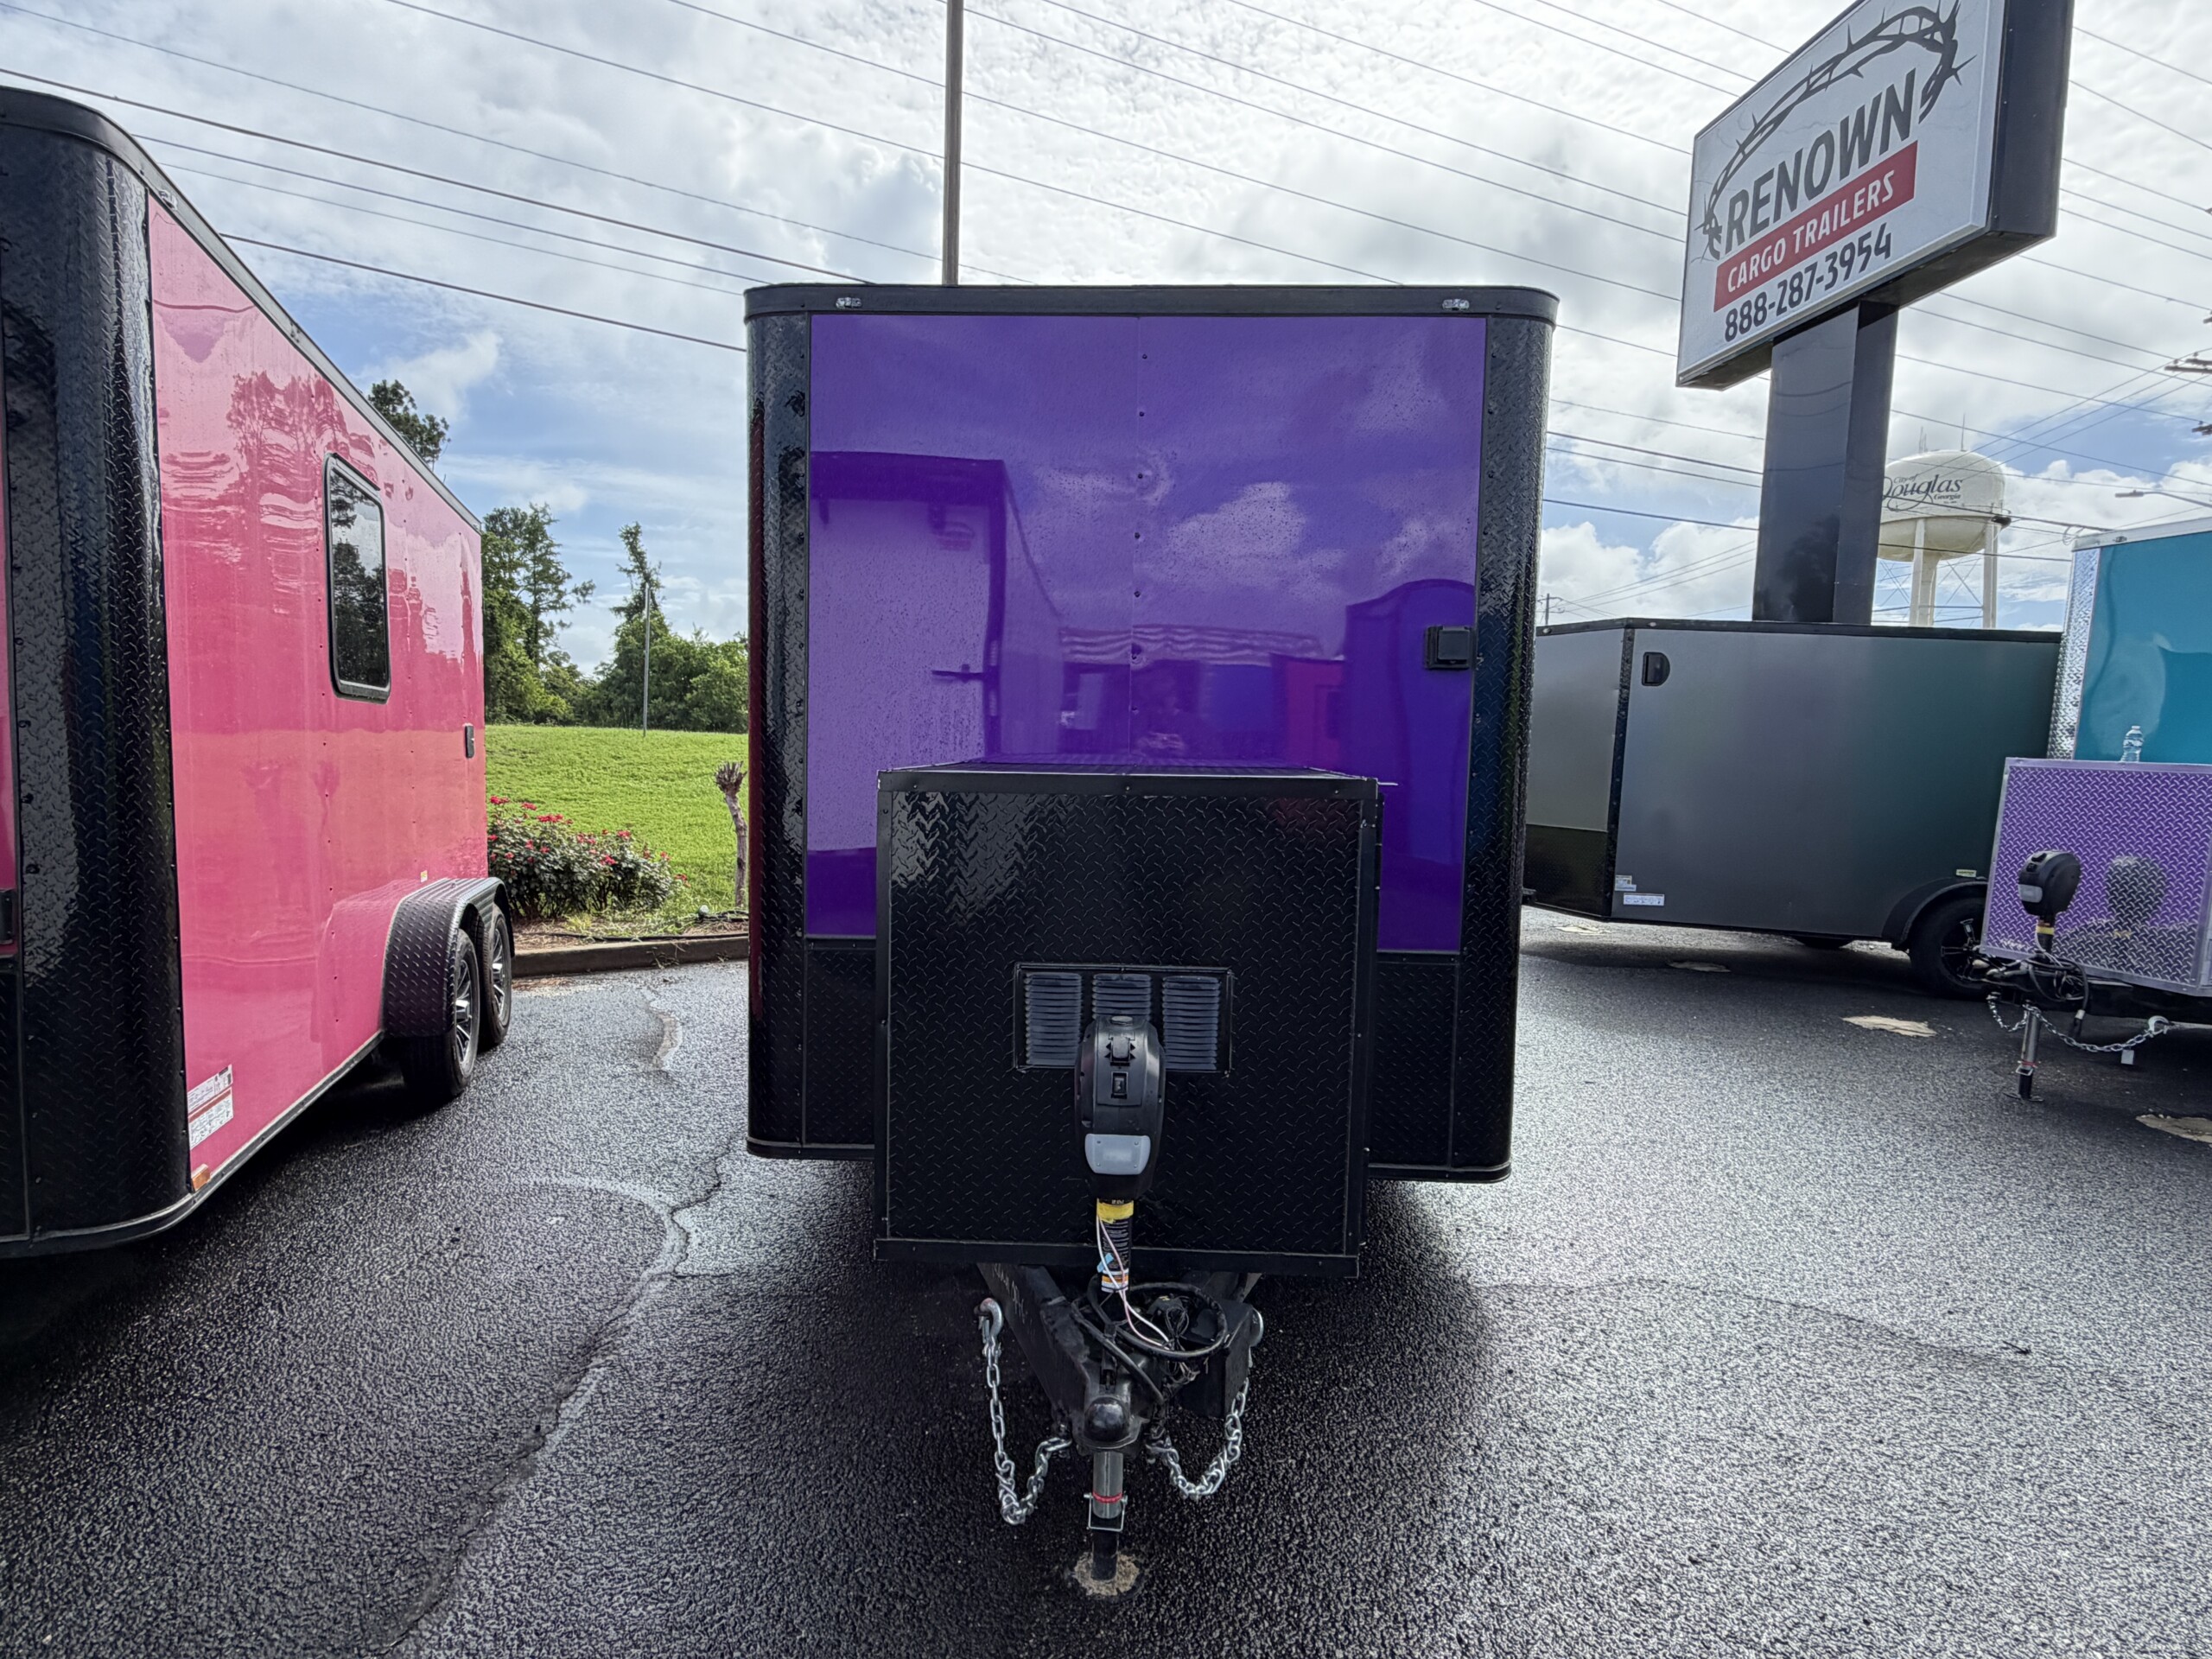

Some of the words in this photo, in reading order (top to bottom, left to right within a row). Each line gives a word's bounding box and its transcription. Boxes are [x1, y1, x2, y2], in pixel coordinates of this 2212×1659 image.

[1725, 67, 1916, 254] RENOWN
[1725, 222, 1892, 342] 888-287-3954
[1727, 238, 1786, 293] CARGO
[1793, 169, 1895, 255] TRAILERS
